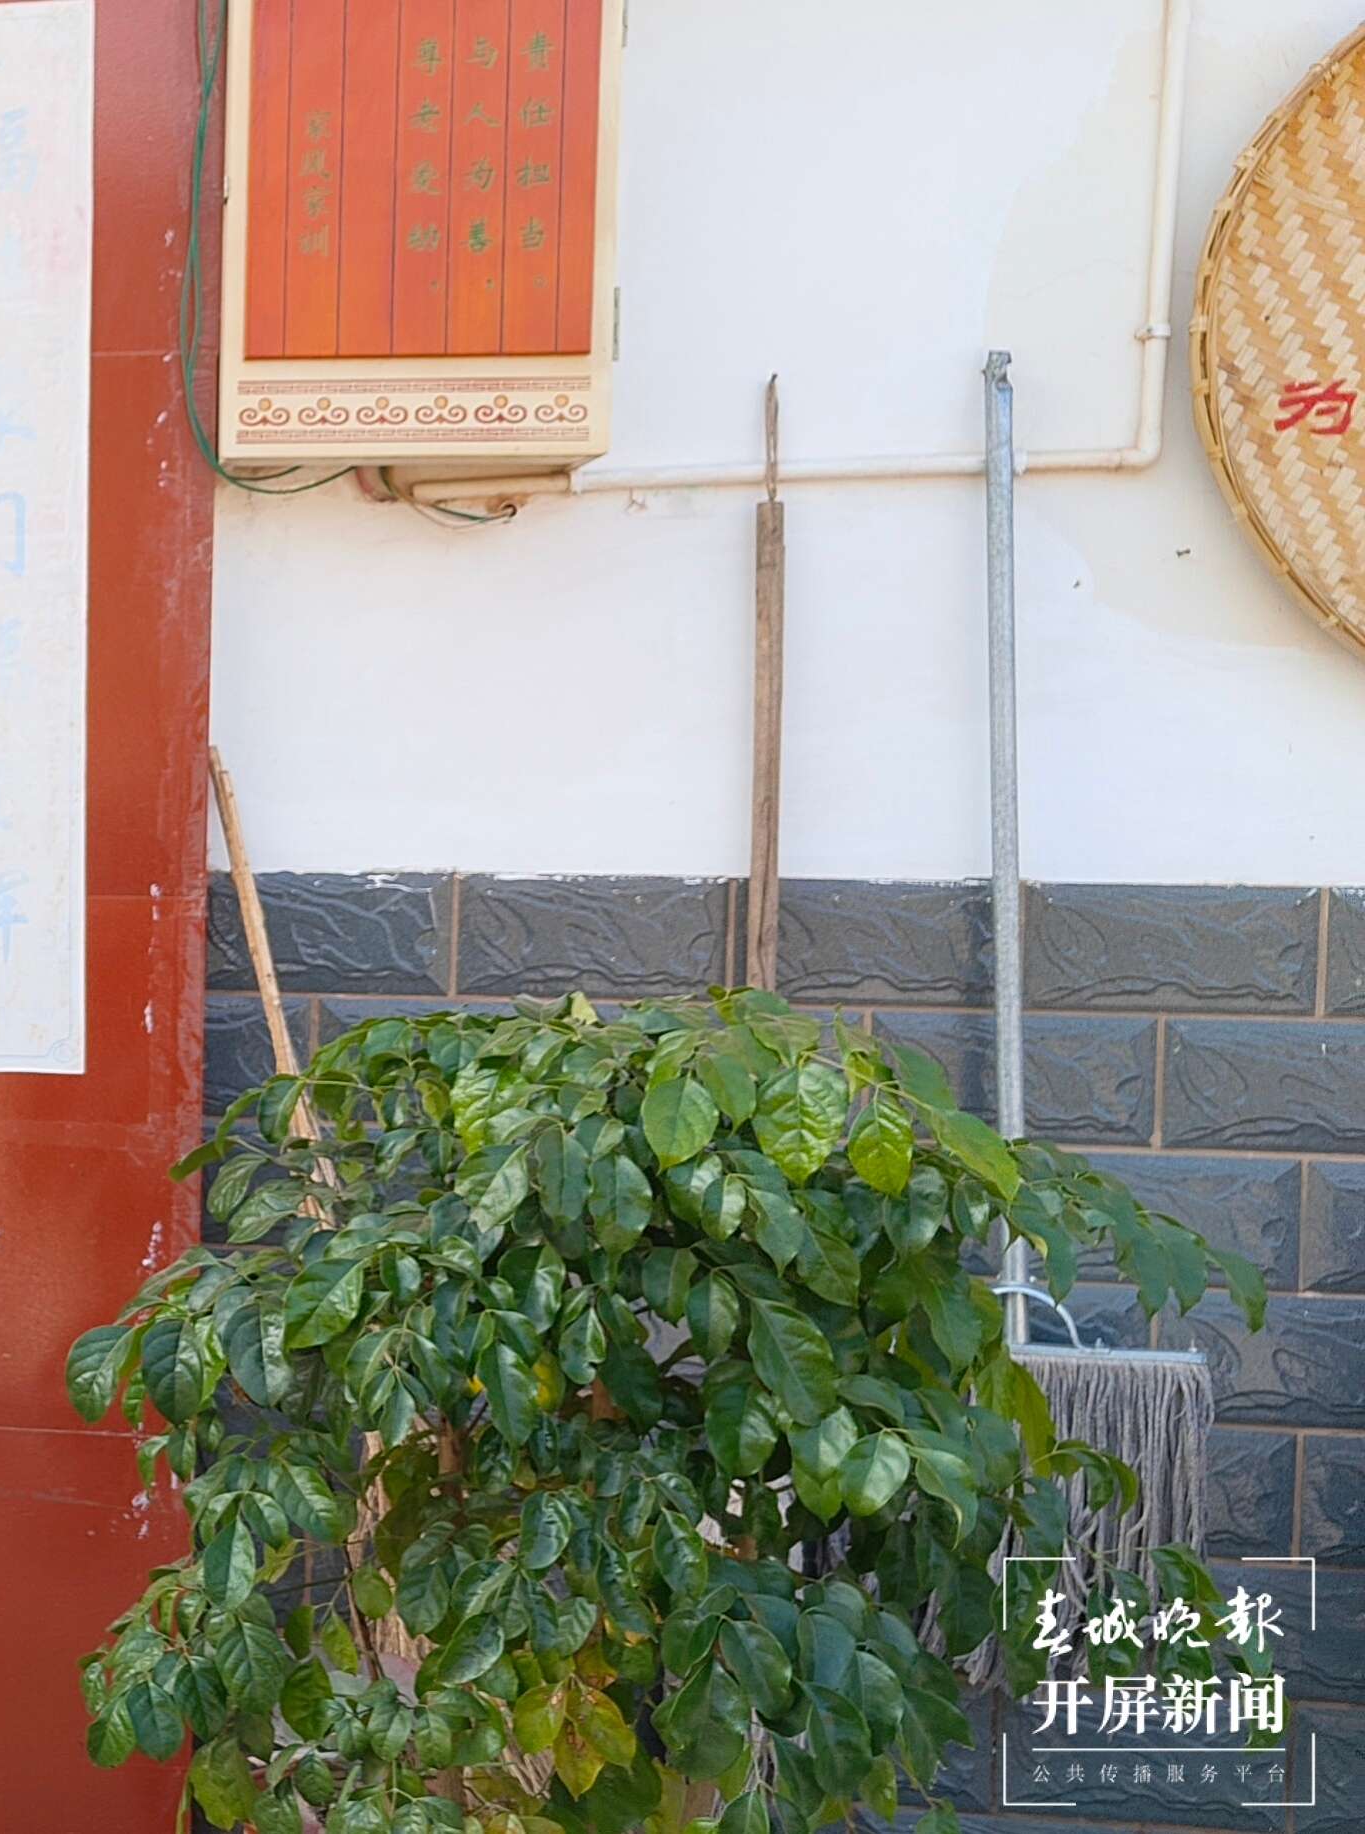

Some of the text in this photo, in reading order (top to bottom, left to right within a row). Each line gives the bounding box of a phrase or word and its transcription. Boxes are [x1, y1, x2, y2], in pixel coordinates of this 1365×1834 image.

[297, 109, 333, 257] 家风家训
[1273, 378, 1358, 436] 为
